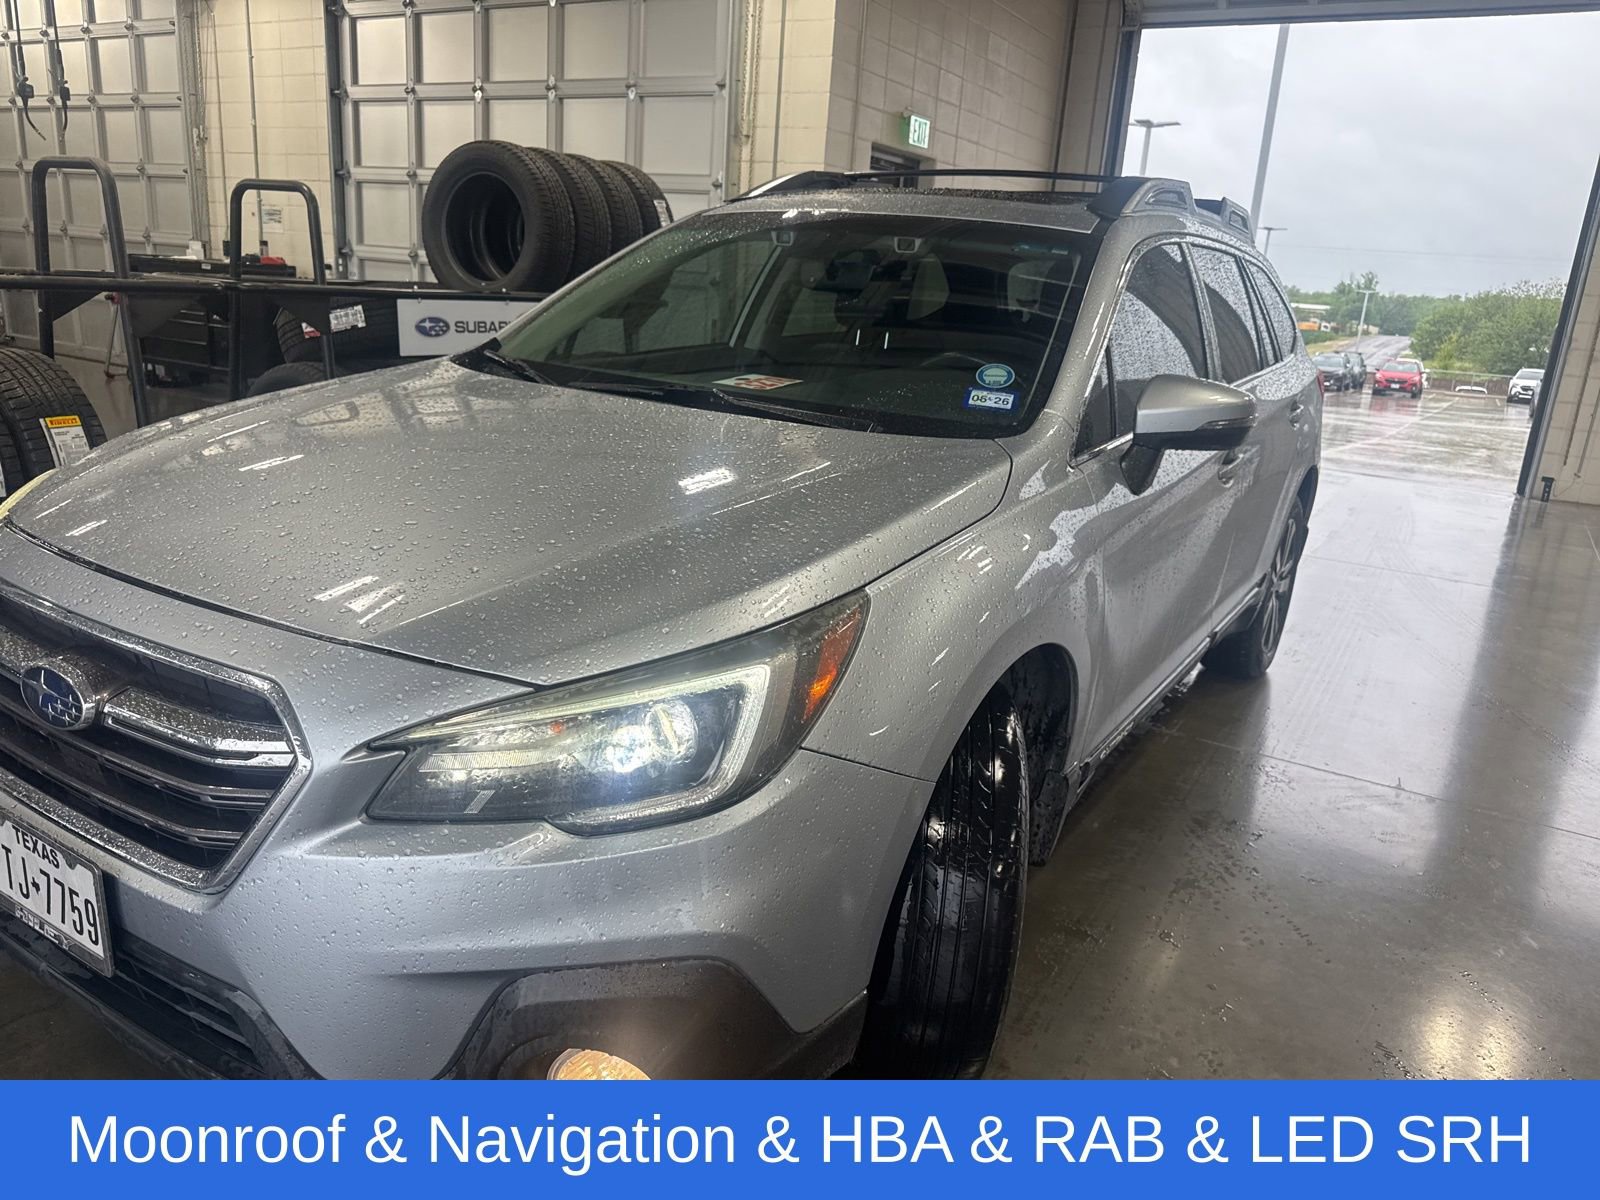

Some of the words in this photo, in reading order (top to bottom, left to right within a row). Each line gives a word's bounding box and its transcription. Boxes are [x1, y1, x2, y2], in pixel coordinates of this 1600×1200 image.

[912, 118, 928, 146] EXIT
[993, 396, 1010, 406] 26
[12, 824, 60, 869] TEXAS
